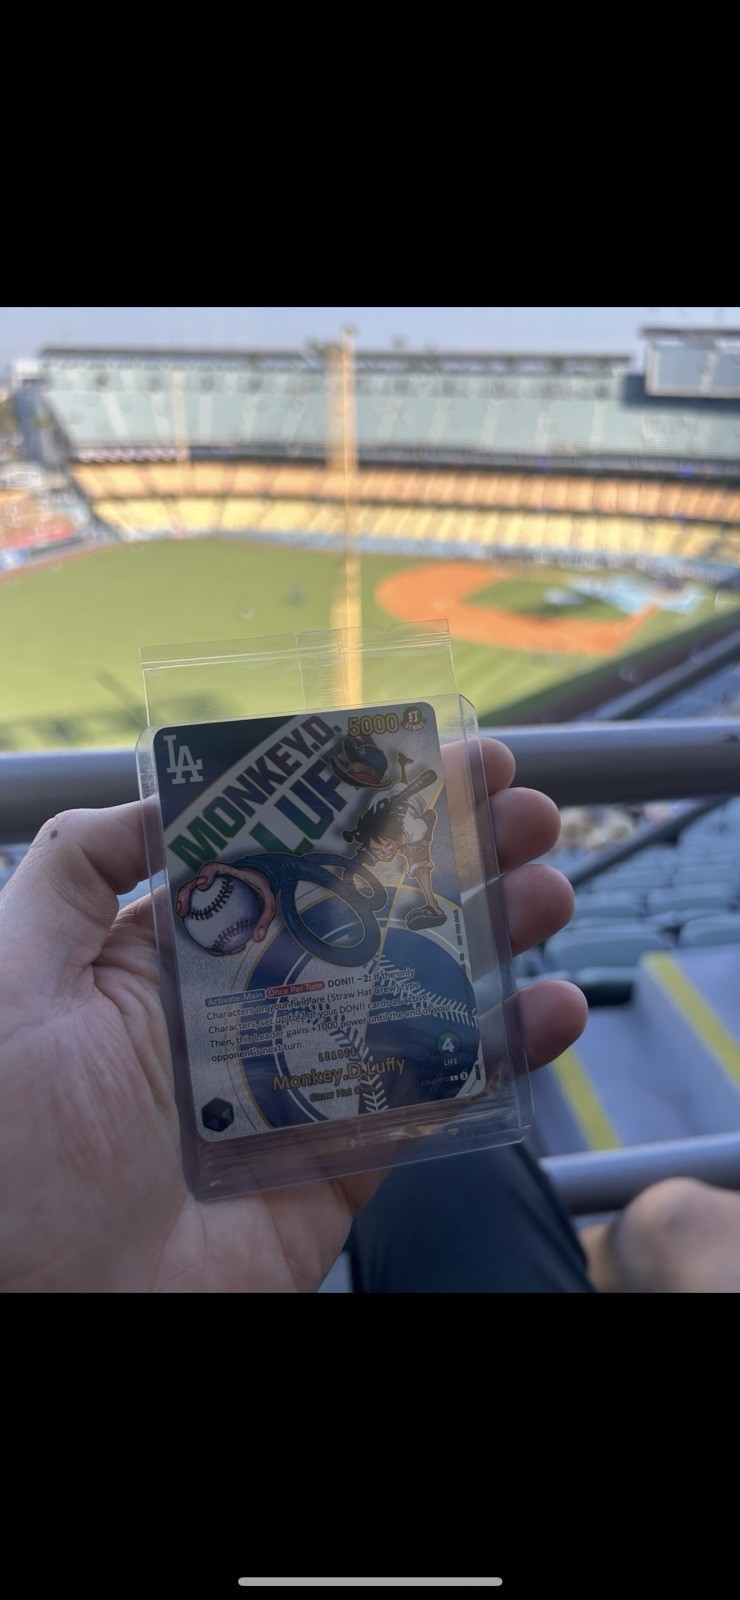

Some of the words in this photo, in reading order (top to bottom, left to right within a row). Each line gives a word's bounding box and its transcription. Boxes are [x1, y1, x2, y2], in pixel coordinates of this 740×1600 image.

[347, 712, 399, 737] 5000
[268, 987, 289, 997] Once
[290, 985, 304, 994] Per
[306, 983, 324, 992] Turn
[327, 976, 355, 988] DON!!
[381, 970, 395, 980] the
[397, 967, 415, 978] only
[206, 1006, 255, 1020] Characters
[268, 1003, 290, 1014] your
[291, 997, 312, 1007] field
[314, 996, 326, 1004] are
[357, 988, 372, 997] Hat
[401, 981, 420, 992] type
[208, 1021, 259, 1034] Characters,
[260, 1017, 273, 1026] set
[275, 1016, 287, 1026] up
[288, 1013, 298, 1022] to
[307, 1010, 317, 1019] of
[319, 1008, 337, 1020] your
[339, 1003, 365, 1014] DON!!
[367, 999, 389, 1010] cards
[210, 1037, 234, 1048] Then,
[236, 1034, 251, 1044] this
[253, 1031, 284, 1042] Leader
[286, 1027, 309, 1038] gains
[311, 1021, 339, 1032] +1000
[340, 1017, 367, 1029] power
[369, 1012, 388, 1023] until
[389, 1010, 404, 1020] the
[405, 1007, 422, 1017] end
[422, 1005, 433, 1014] of
[433, 1003, 451, 1015] your
[211, 1048, 261, 1062] opponent's
[262, 1045, 281, 1054] next
[283, 1042, 305, 1051] turn.
[442, 1037, 455, 1052] 4
[443, 1057, 459, 1066] LIFE
[309, 1090, 335, 1102] Straw
[336, 1087, 352, 1098] Hat
